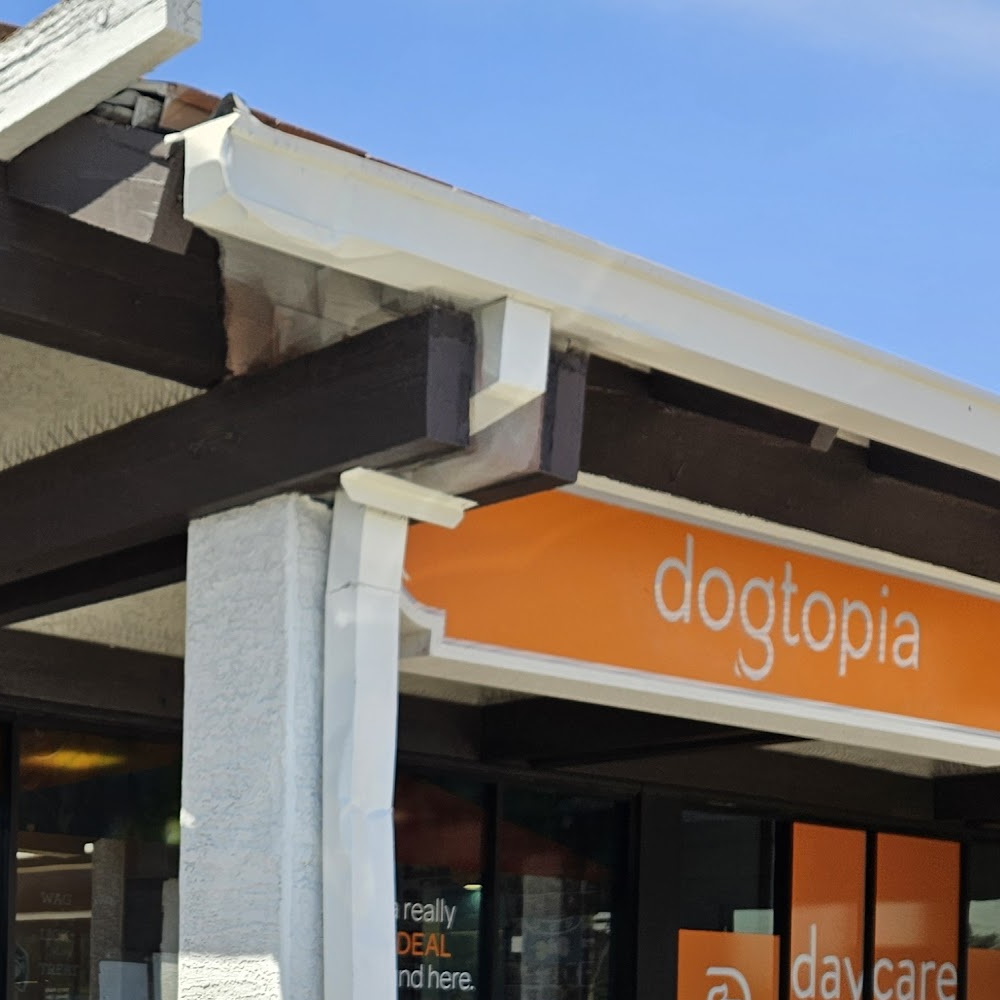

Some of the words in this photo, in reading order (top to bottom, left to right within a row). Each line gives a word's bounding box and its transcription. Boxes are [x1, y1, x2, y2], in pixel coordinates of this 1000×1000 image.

[653, 533, 922, 681] dogtopia
[403, 897, 457, 930] really
[397, 930, 452, 958] DEAL
[427, 963, 477, 993] here.
